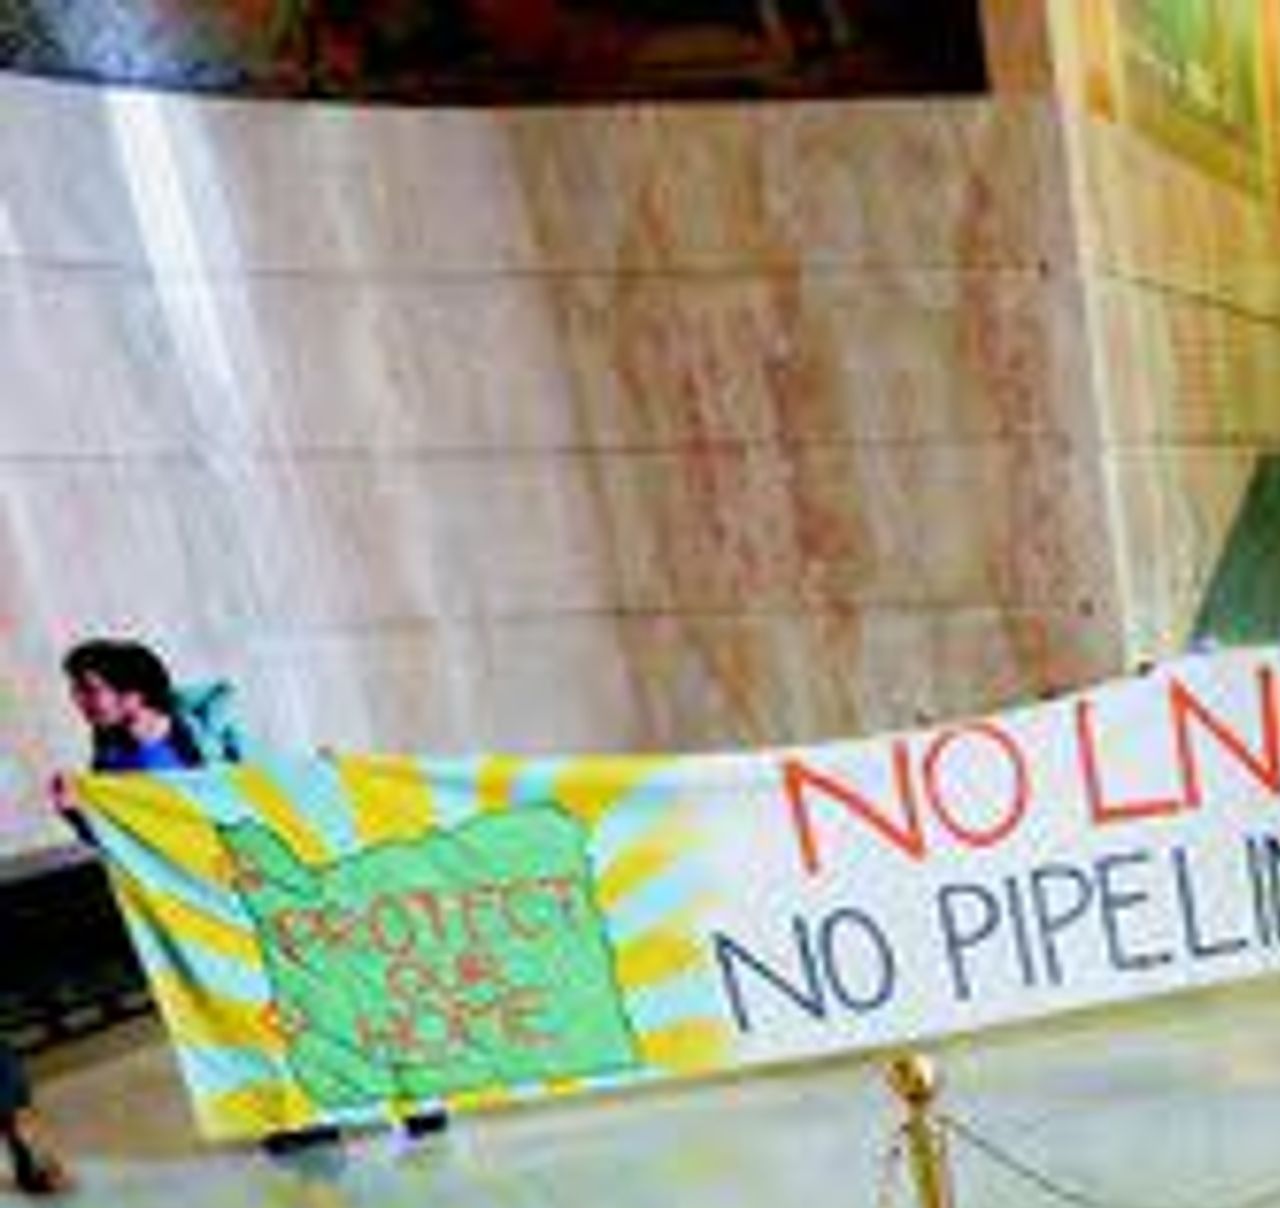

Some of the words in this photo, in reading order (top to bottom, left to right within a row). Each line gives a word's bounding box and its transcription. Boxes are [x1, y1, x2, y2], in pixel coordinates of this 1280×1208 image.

[780, 718, 1030, 876] NO
[275, 873, 582, 968] PROTECT
[712, 903, 898, 1034] NO
